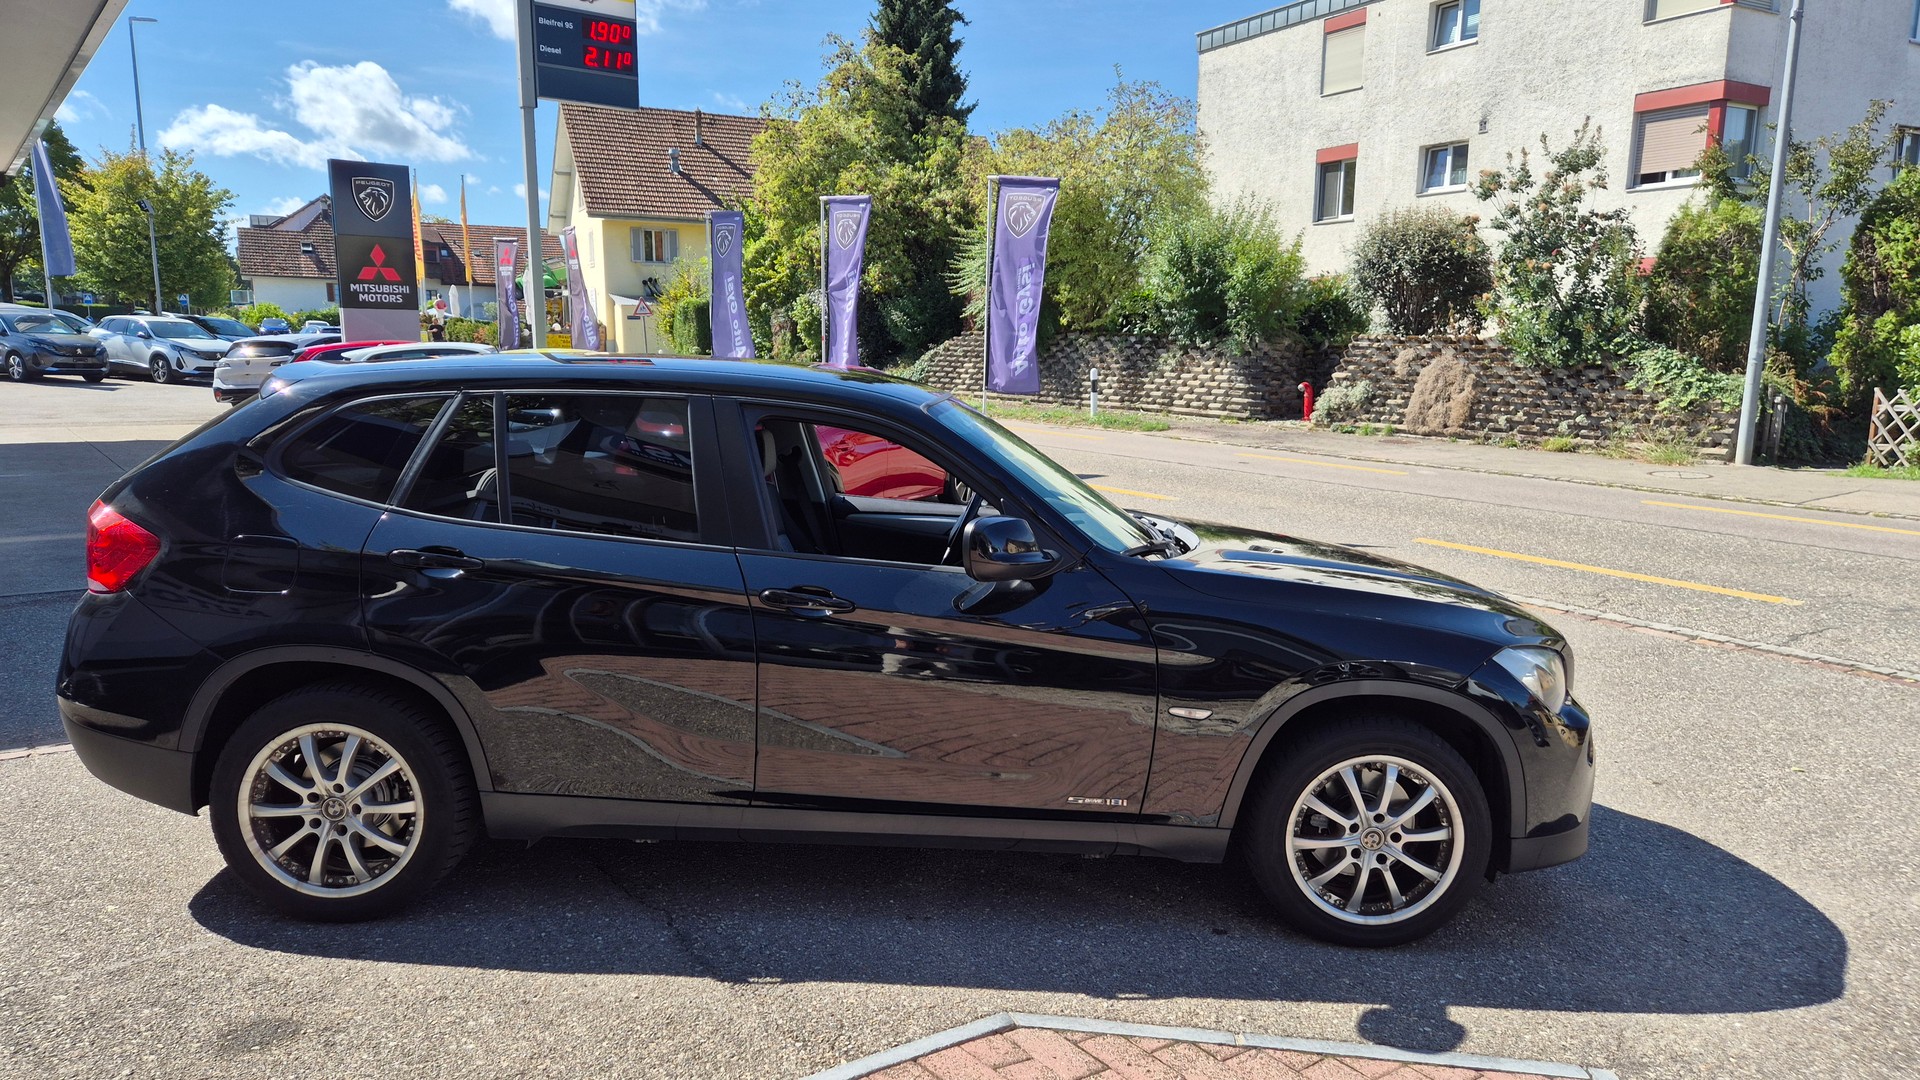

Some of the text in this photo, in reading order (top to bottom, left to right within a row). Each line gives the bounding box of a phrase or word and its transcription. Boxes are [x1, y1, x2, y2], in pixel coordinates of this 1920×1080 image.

[538, 17, 574, 30] Bleifrei 95
[540, 44, 562, 55] Diesel
[355, 180, 391, 188] PEUGEOT
[350, 283, 410, 294] MITSUBISHI
[359, 293, 403, 303] MOTORS
